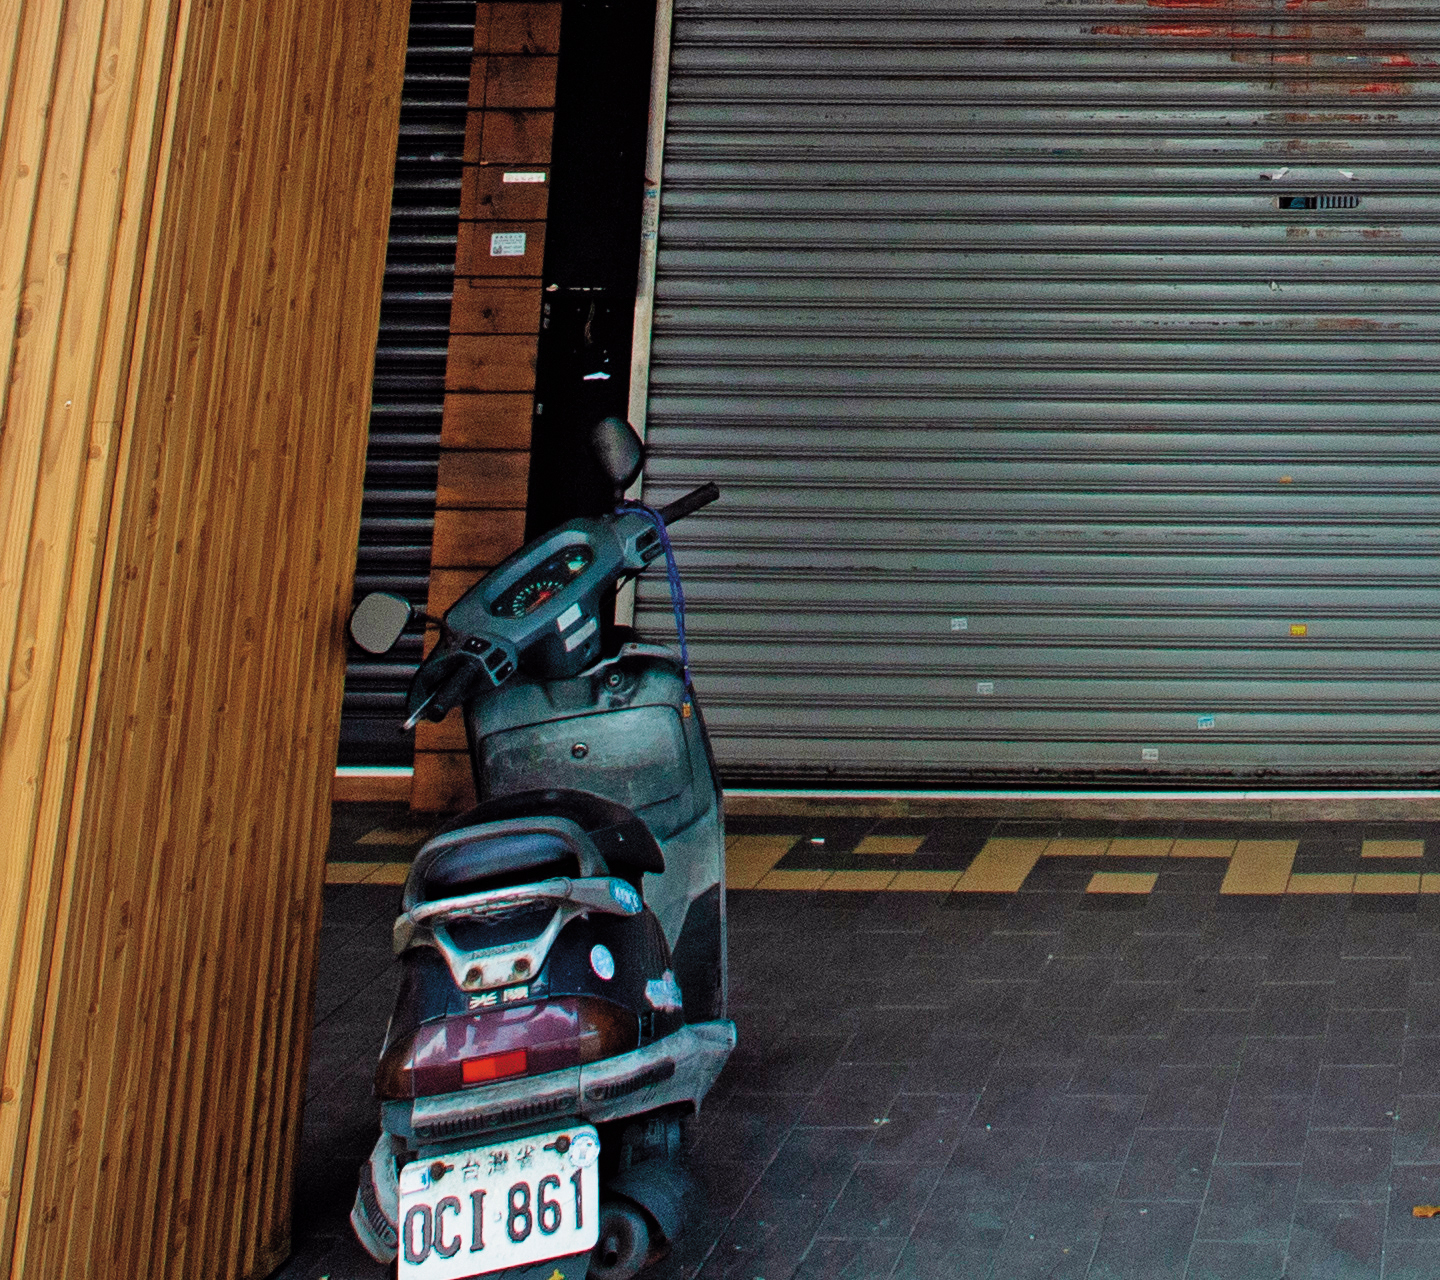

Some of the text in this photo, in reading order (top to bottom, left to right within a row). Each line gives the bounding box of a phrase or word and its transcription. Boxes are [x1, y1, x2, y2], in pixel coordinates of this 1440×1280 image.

[462, 1144, 537, 1182] 台灣省
[506, 1166, 584, 1244] 861
